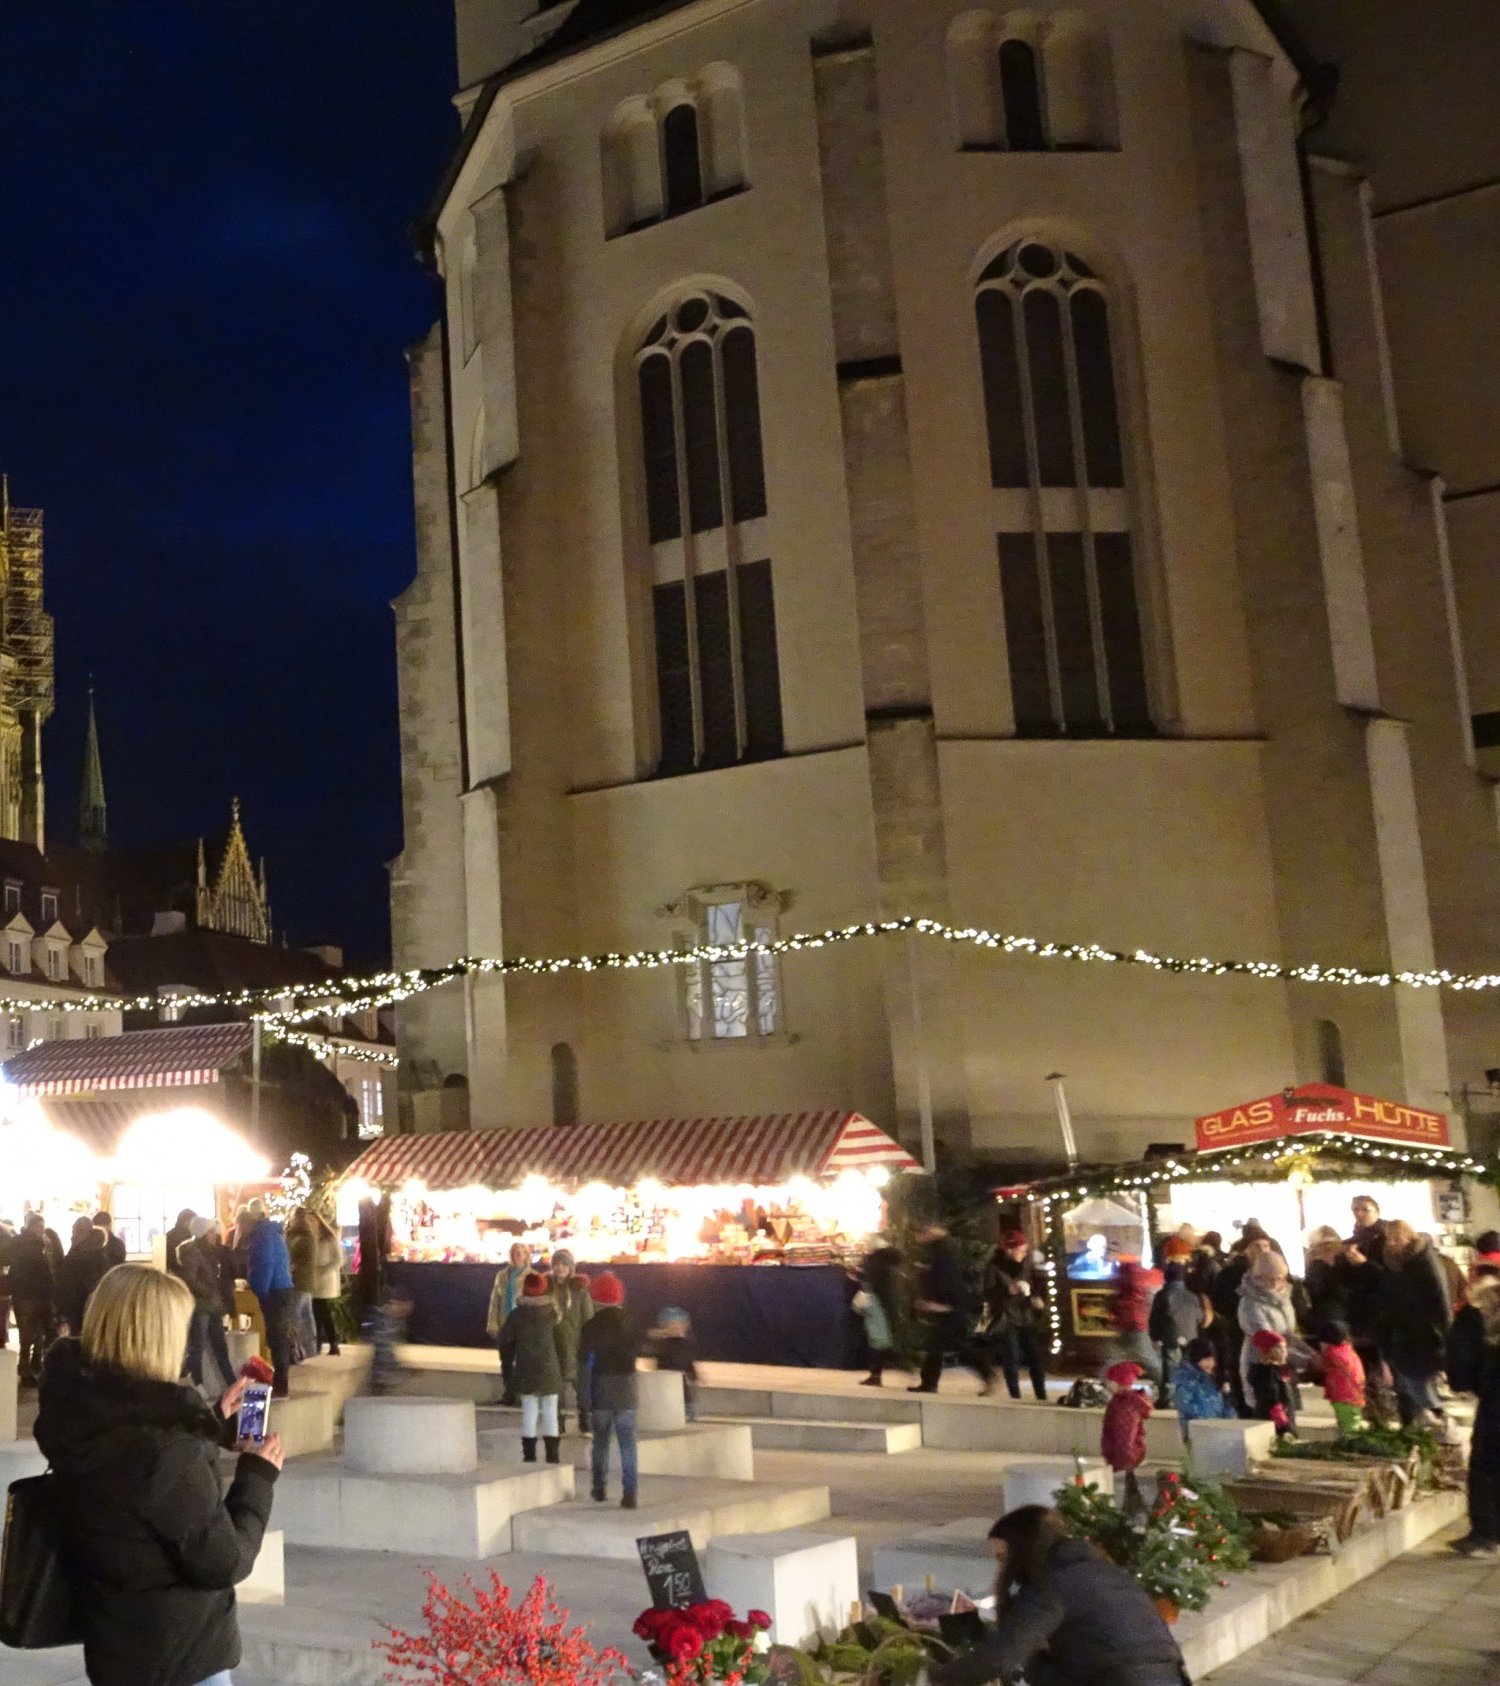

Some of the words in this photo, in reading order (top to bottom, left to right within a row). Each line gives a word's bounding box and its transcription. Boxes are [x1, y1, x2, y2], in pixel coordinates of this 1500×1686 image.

[1202, 1101, 1274, 1136] GLAS
[1294, 1108, 1345, 1123] Fuchs
[1353, 1096, 1440, 1133] HÜTTE
